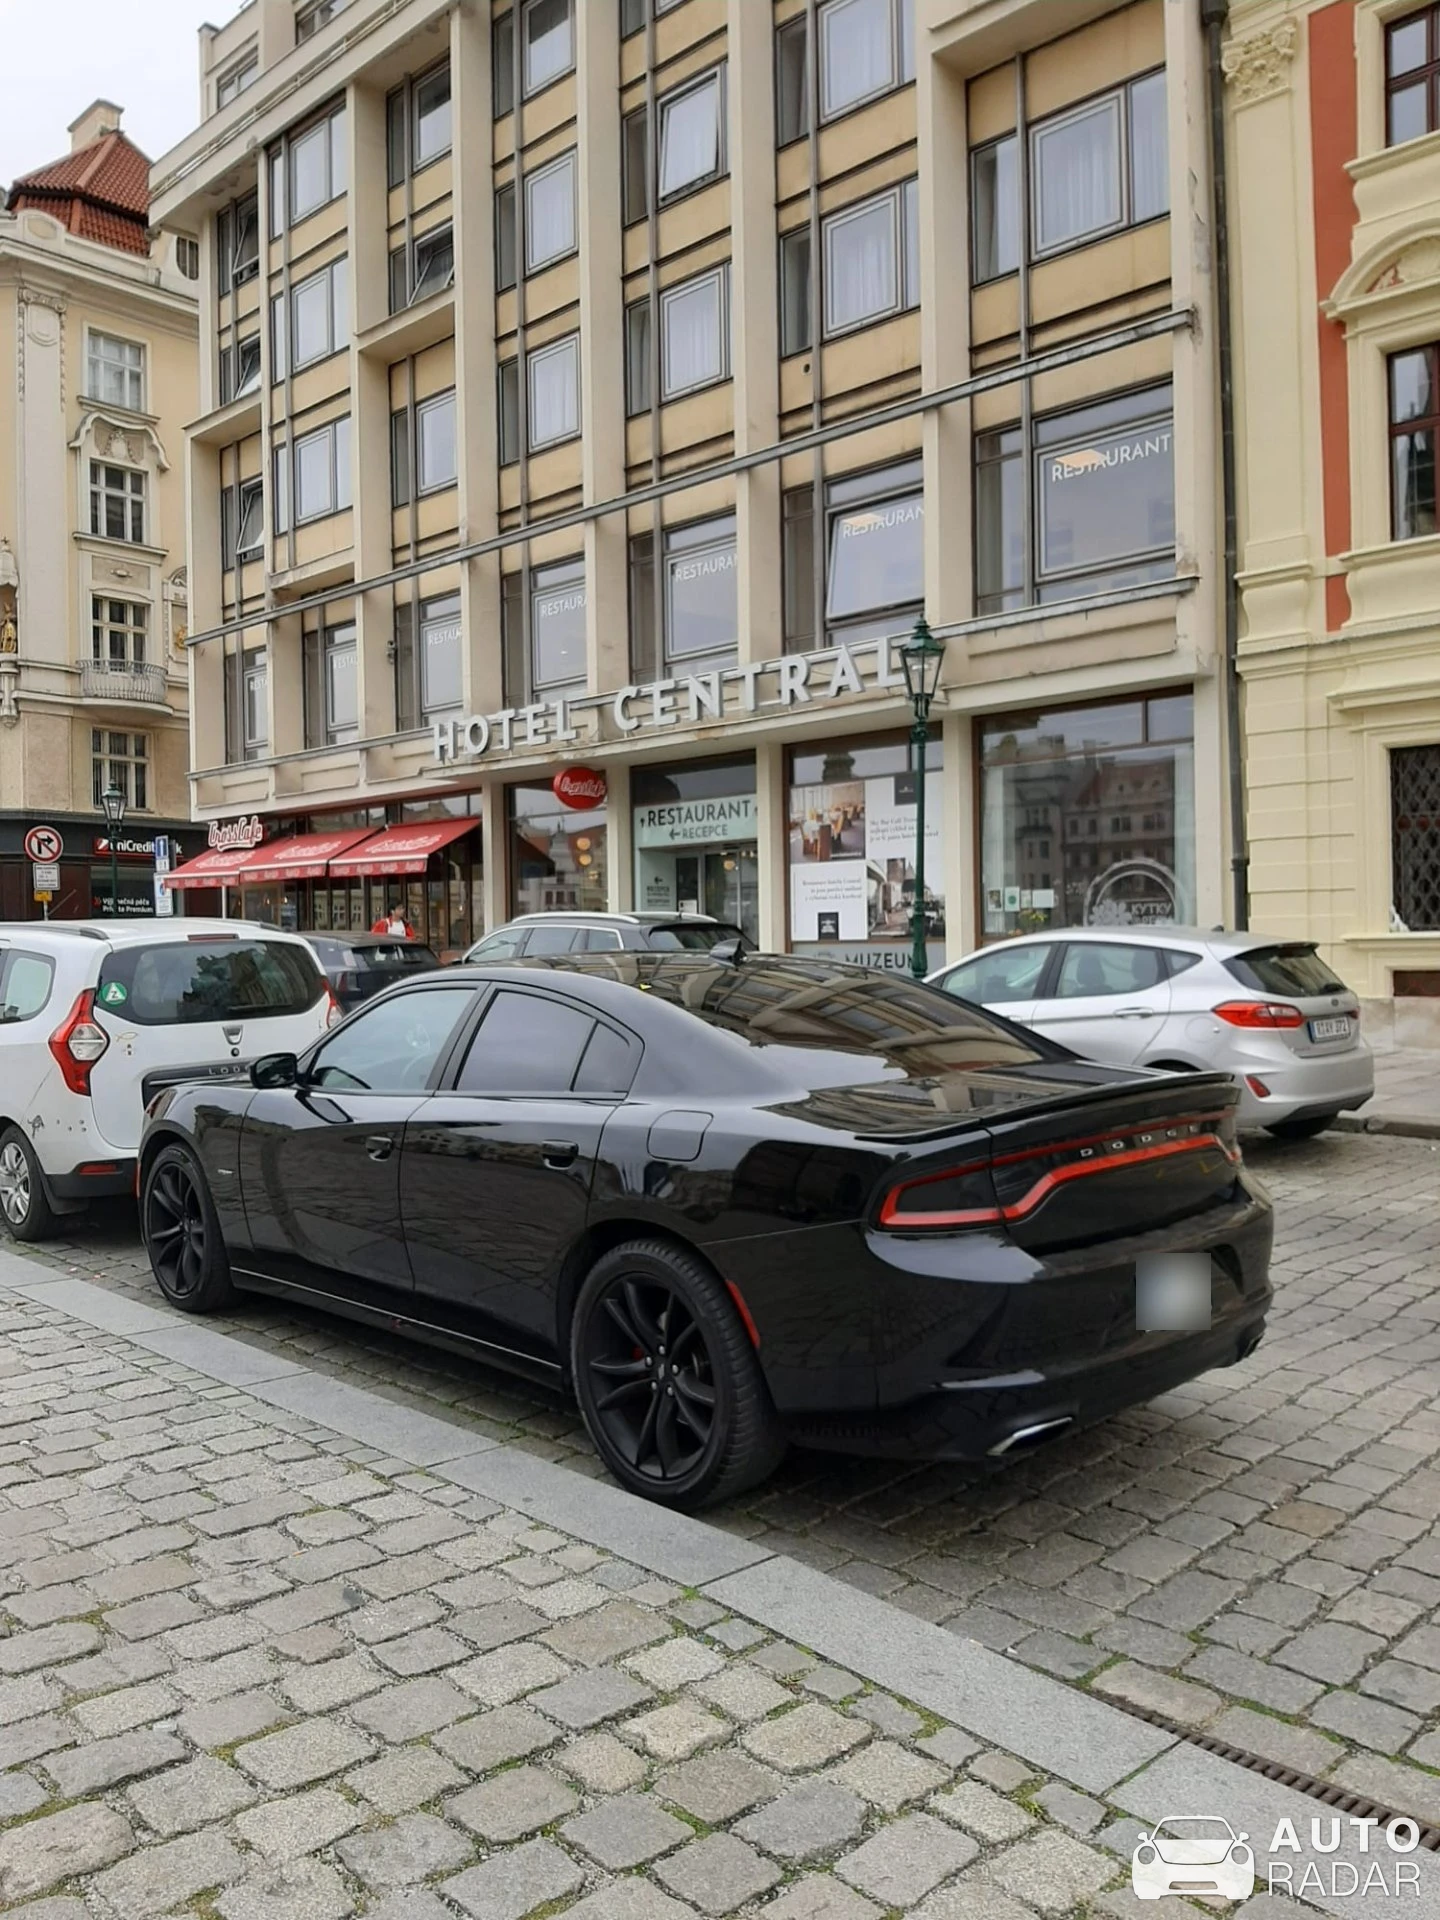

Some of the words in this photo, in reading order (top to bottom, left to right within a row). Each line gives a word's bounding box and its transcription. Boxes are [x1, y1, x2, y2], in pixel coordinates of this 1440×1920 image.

[433, 699, 577, 762] HOTEL
[612, 636, 906, 733] CENTRAL
[648, 799, 750, 827] RESTAURANT
[682, 823, 729, 840] RECEPCE
[1131, 902, 1172, 915] KYTKY
[1080, 1124, 1199, 1157] DODGE
